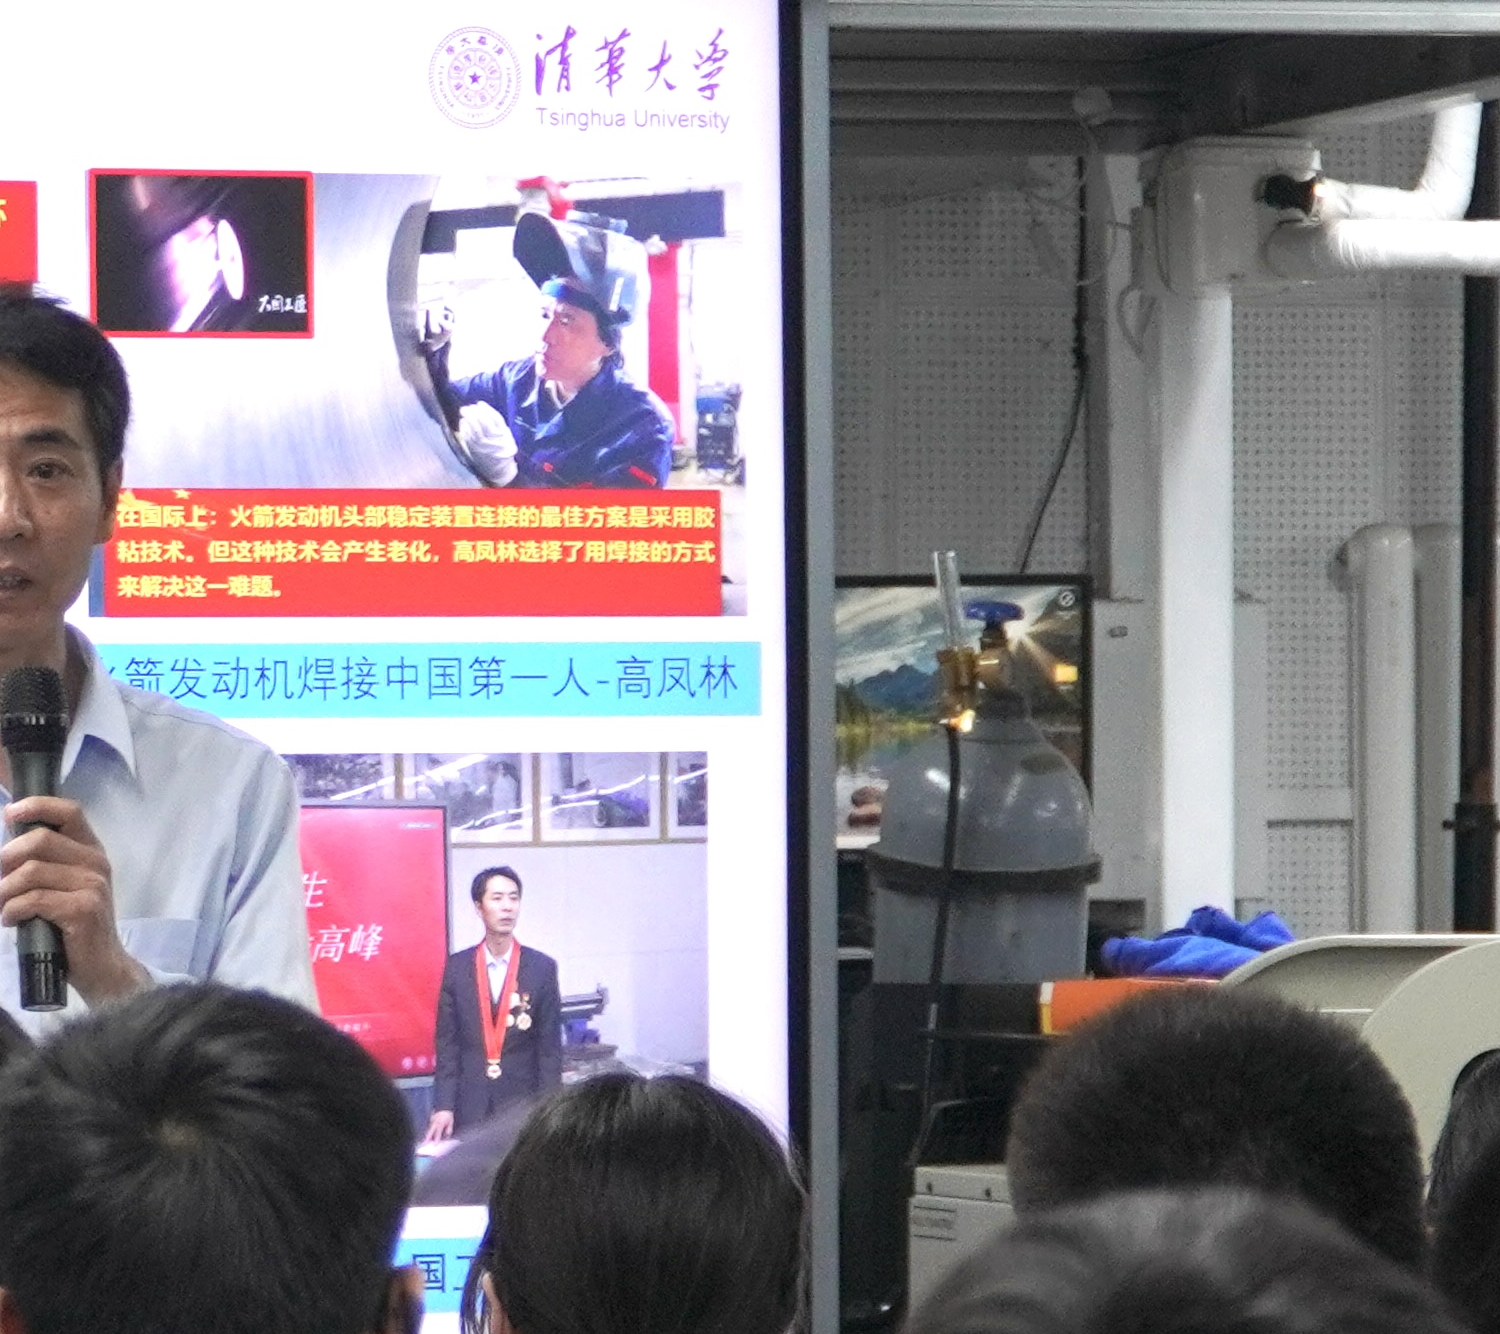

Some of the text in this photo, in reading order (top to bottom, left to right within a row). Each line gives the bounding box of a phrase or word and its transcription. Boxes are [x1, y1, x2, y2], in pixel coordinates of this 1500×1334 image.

[535, 107, 731, 134] Tsinghua University
[117, 575, 283, 599] 来解决这一难题。
[101, 654, 738, 702] 箭发动机焊接中国第一人-高凤林
